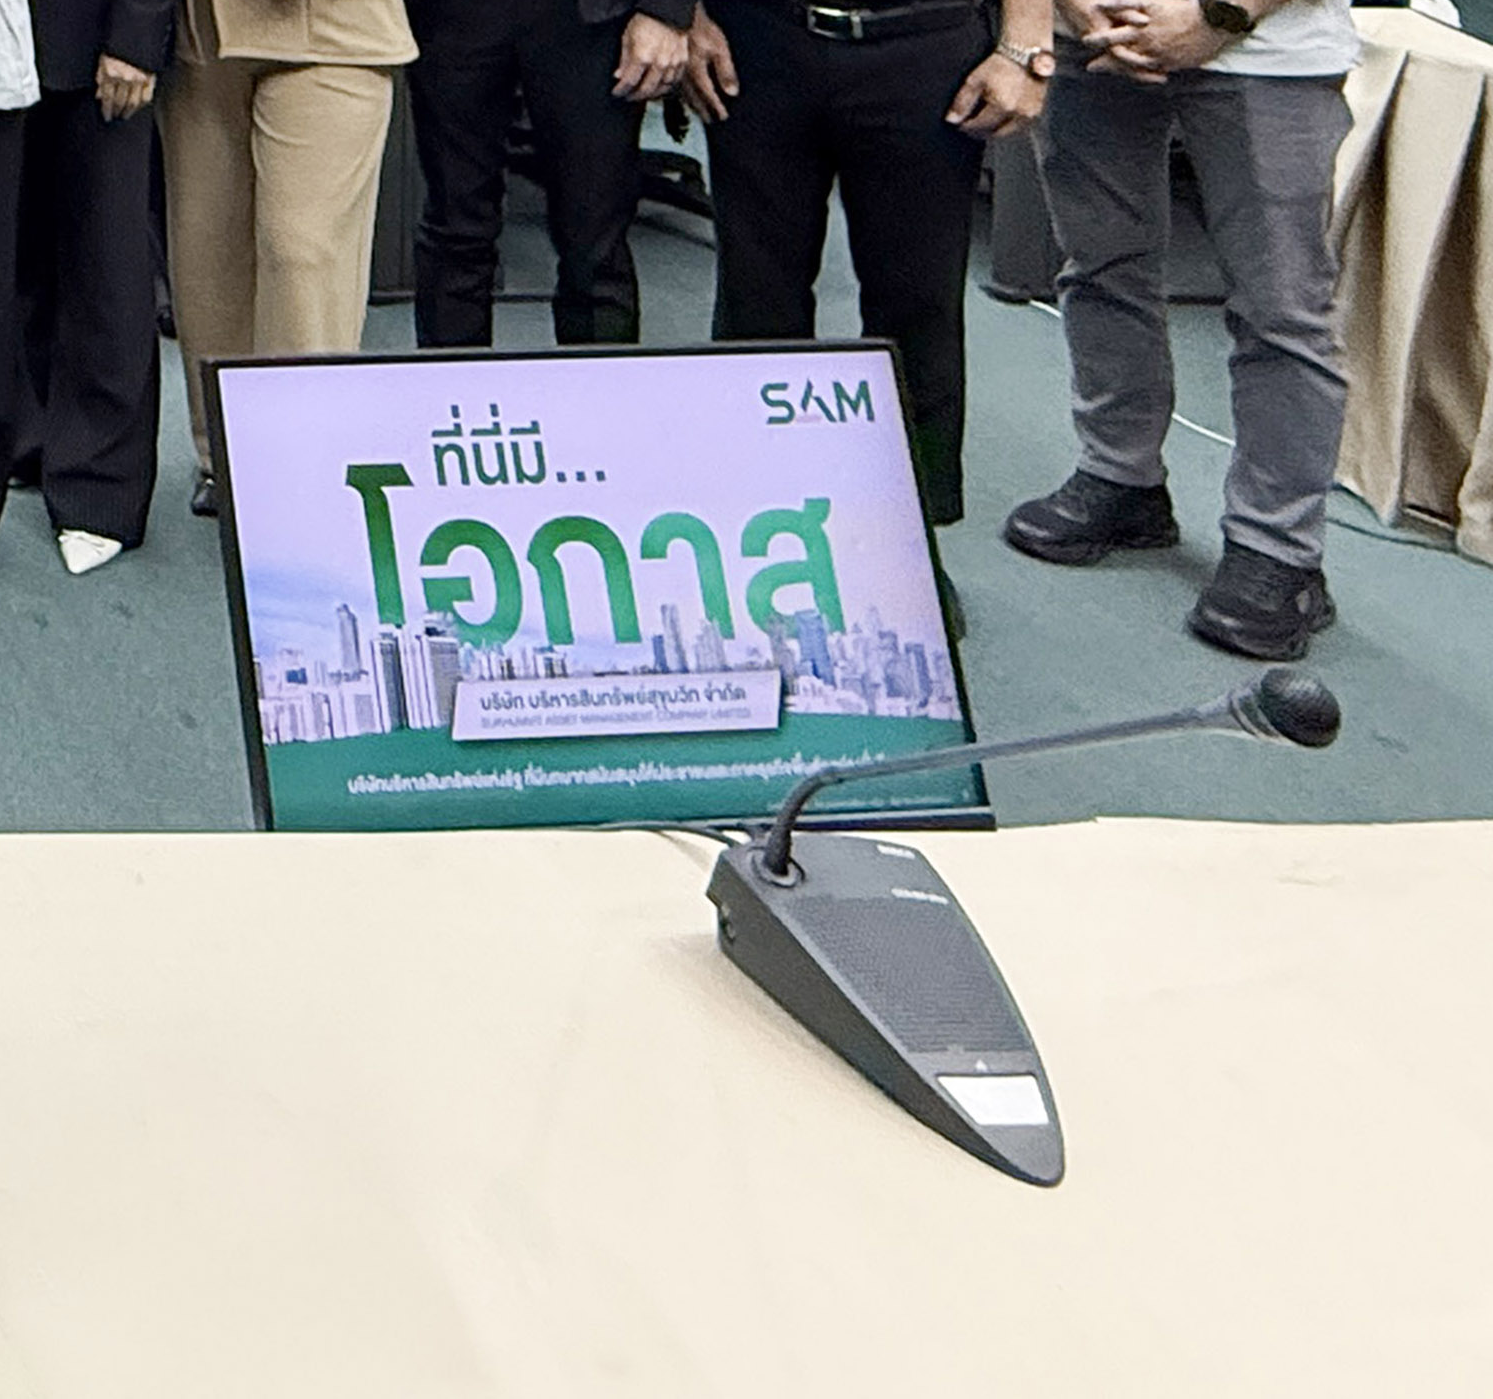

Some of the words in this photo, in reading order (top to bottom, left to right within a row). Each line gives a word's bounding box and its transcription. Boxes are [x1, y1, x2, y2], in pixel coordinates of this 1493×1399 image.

[759, 378, 875, 425] SAM
[430, 404, 607, 487] ที่นี่มี...
[344, 462, 845, 647] โอกาส
